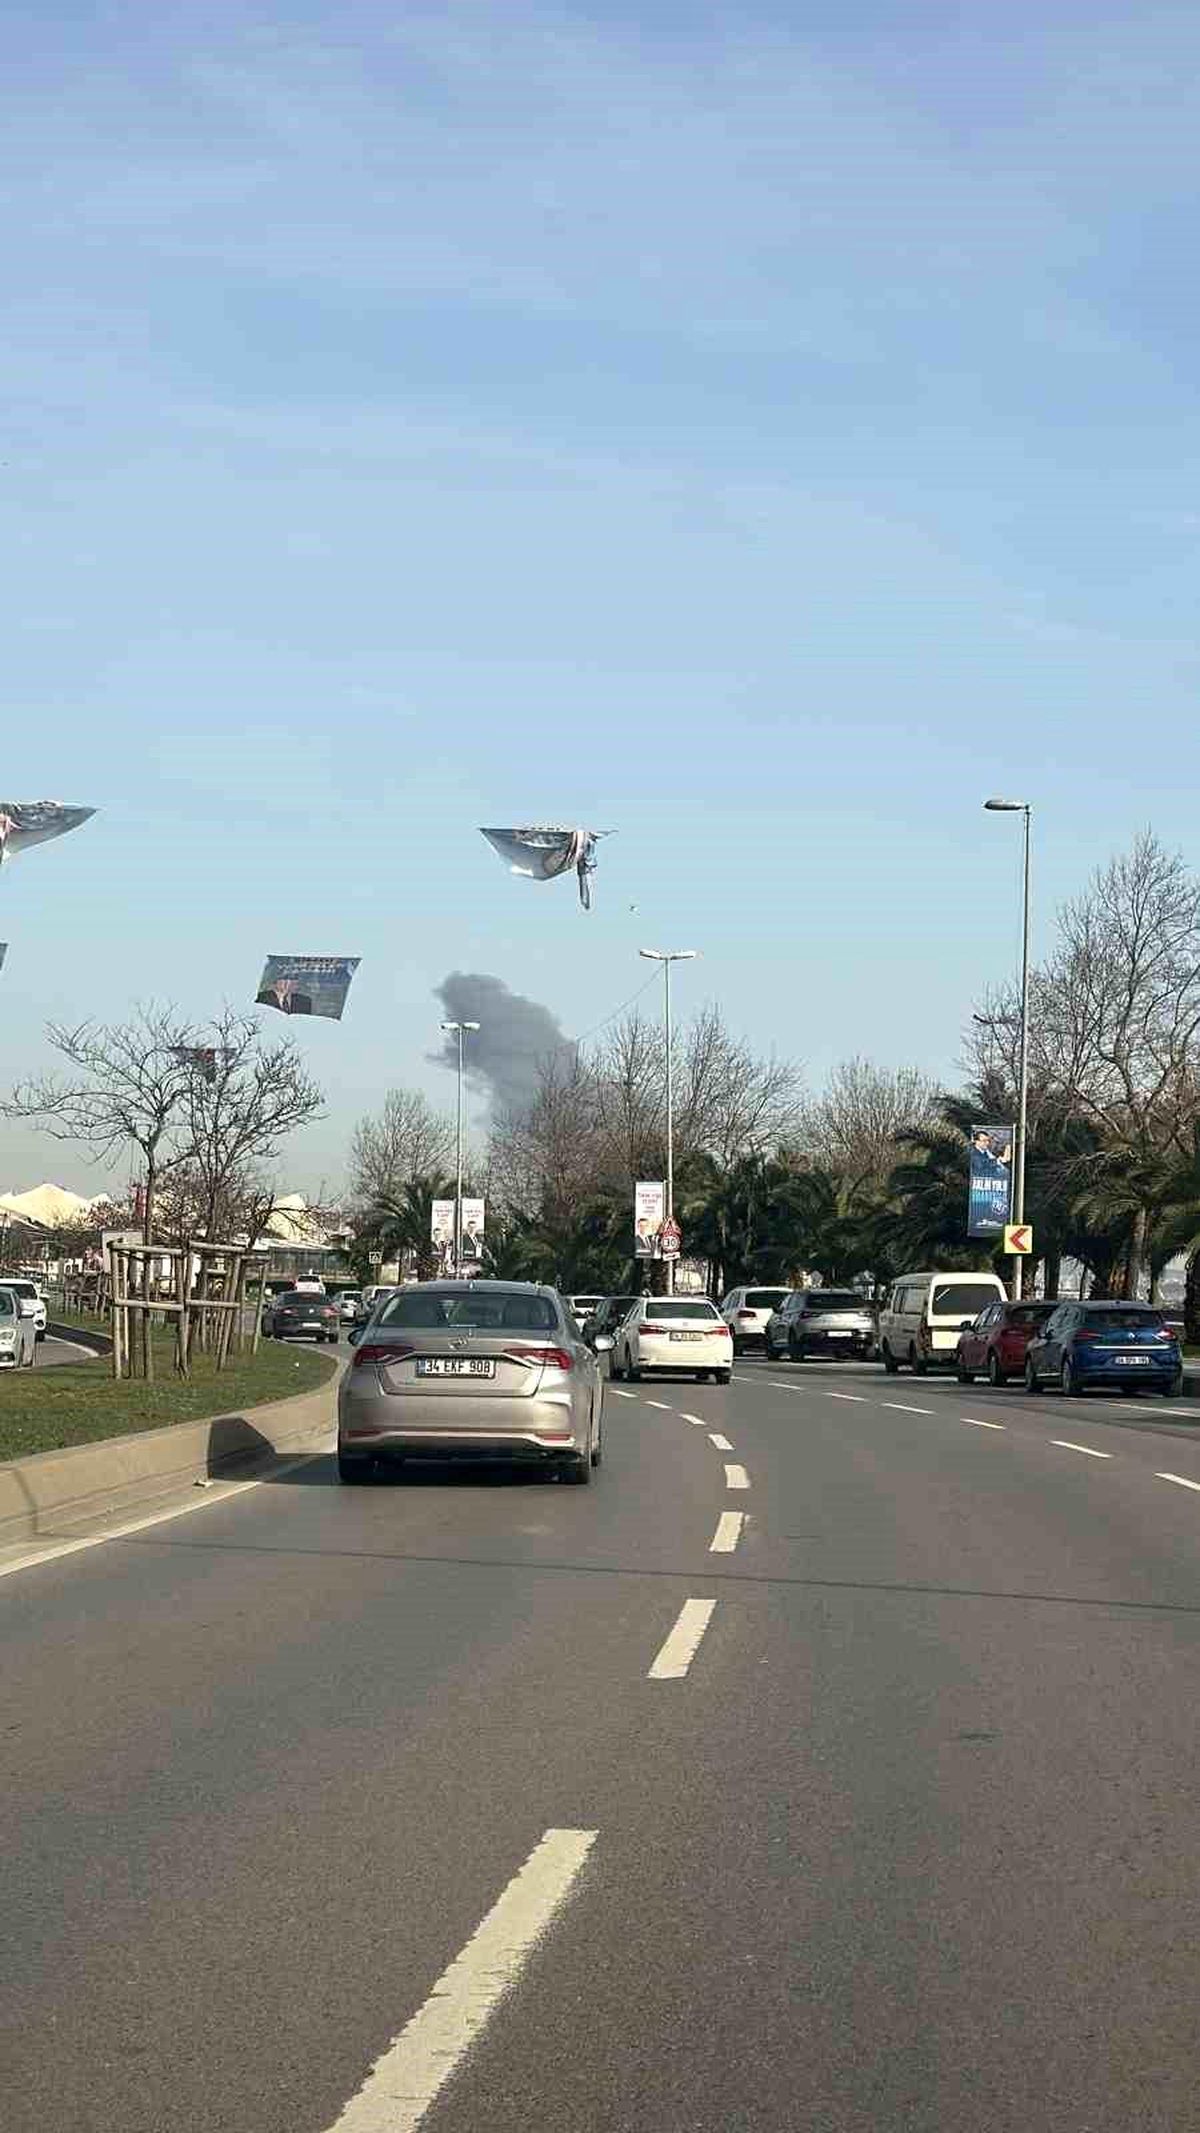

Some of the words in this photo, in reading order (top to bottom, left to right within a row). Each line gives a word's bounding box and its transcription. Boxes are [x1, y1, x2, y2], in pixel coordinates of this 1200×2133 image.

[426, 1359, 440, 1373] 34
[443, 1359, 464, 1373] EKF
[469, 1359, 491, 1373] 908
